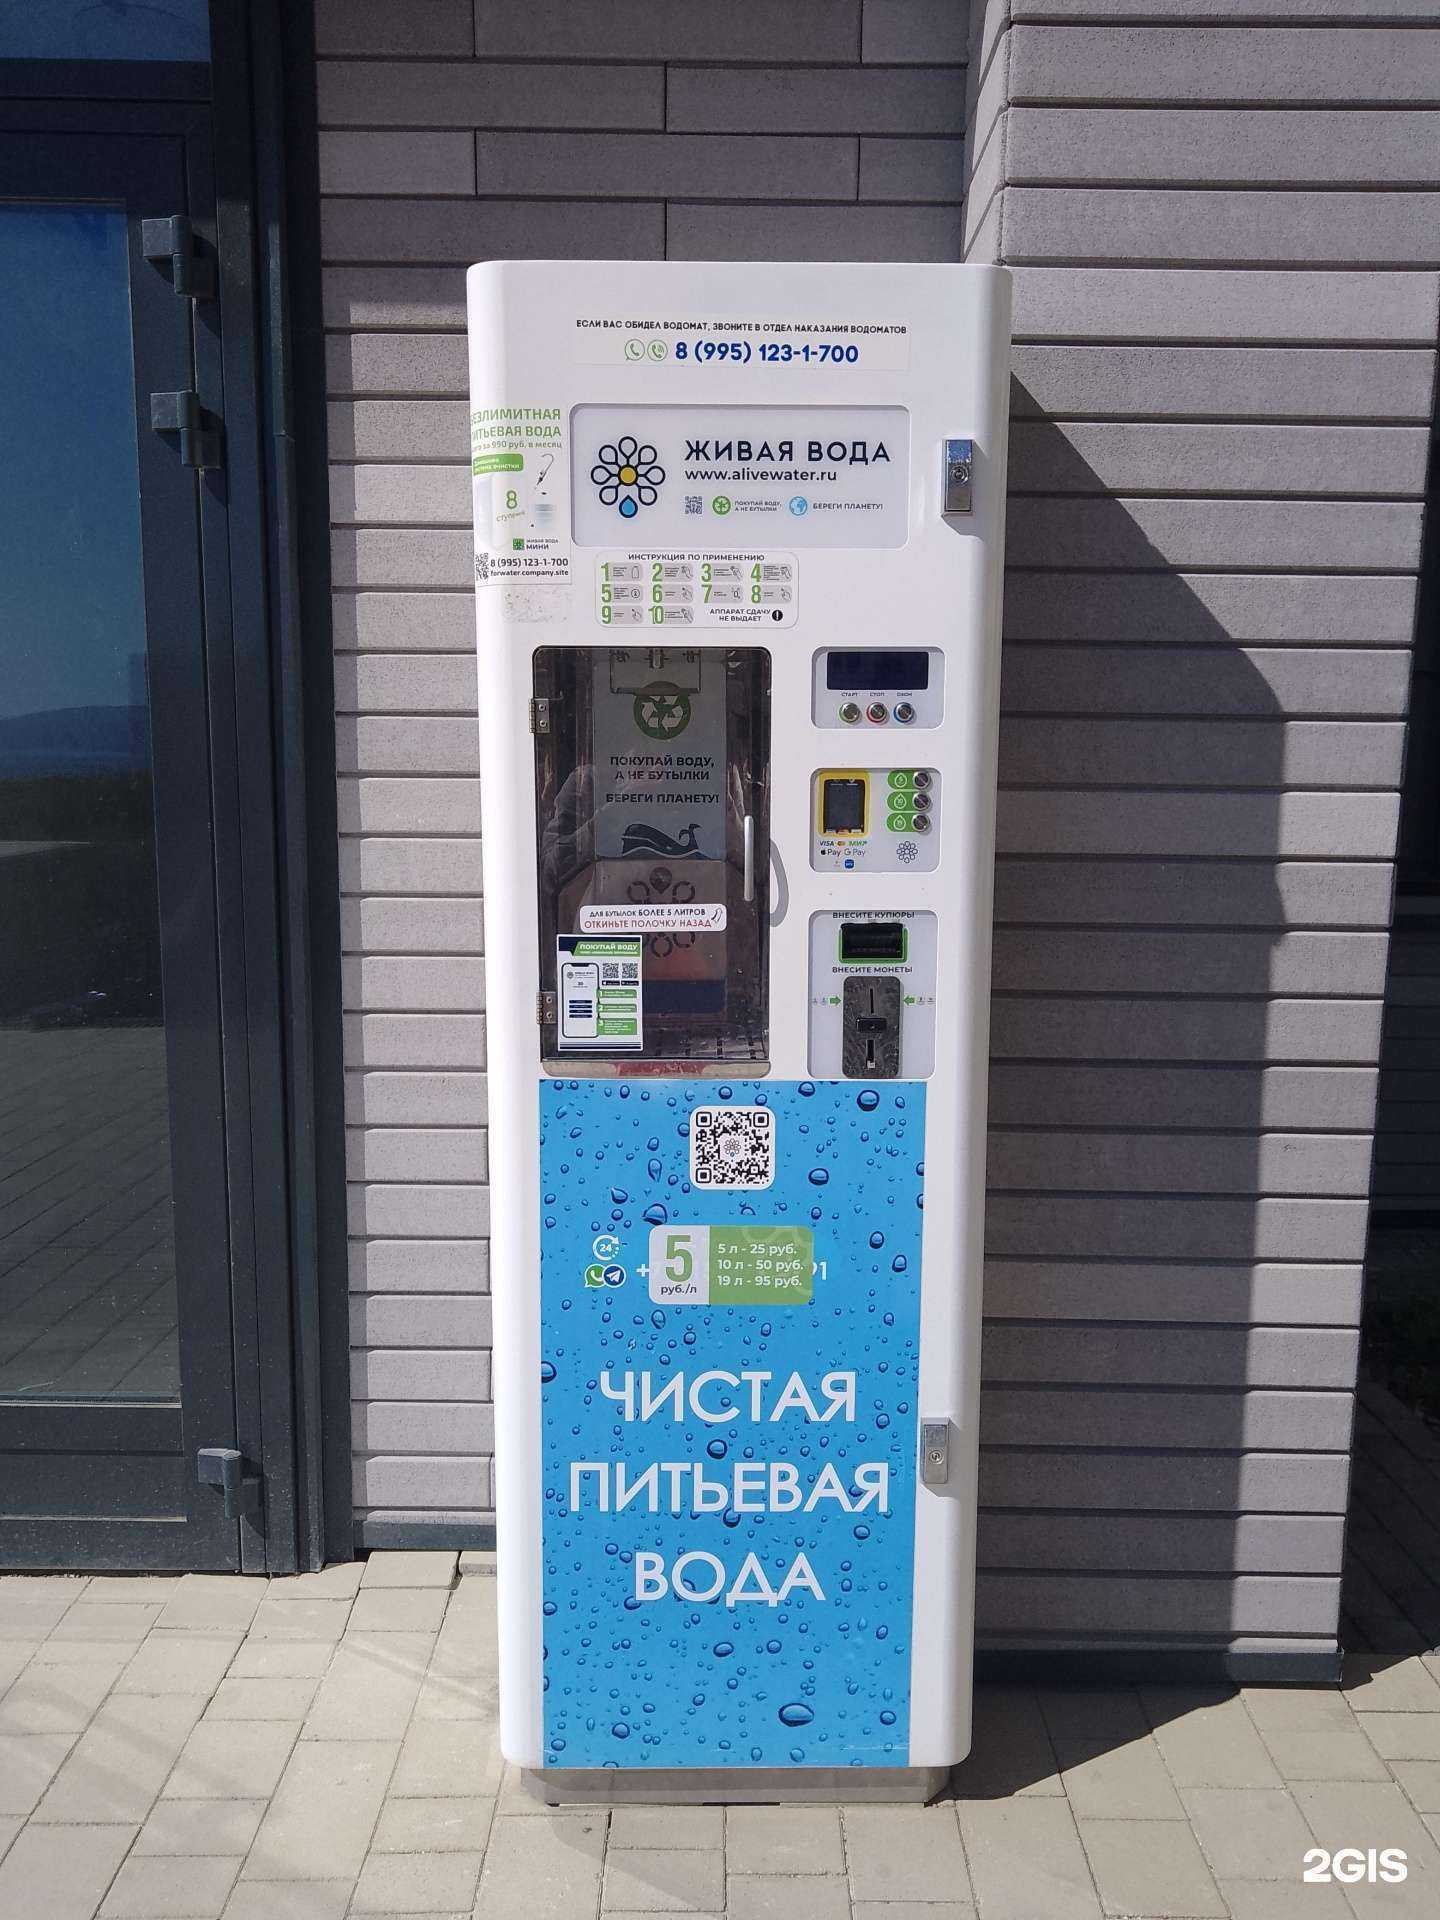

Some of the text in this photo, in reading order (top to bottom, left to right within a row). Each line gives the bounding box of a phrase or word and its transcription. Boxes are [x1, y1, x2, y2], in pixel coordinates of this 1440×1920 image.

[576, 320, 906, 335] ЕСЛИ ВАС ОБИДЕЛ ВОДОМАТ, ЗВОНИТЕ В ОТДЕЛ НАКАЗАНИЯ ВОДОМАТОВ
[675, 340, 859, 363] 8 (995) 123-1-700
[471, 408, 561, 425] ЕЗЛИМИТНАЯ
[472, 426, 561, 441] ИТЬЕВАЯ ВОДА
[685, 440, 890, 465] ЖИВАЯ ВОДА
[685, 468, 837, 482] www.alivewater.ru
[506, 490, 518, 509] 8
[813, 502, 883, 510] БЕРЕГИ ПЛАНЕТУ!
[490, 558, 568, 568] 8 (995) 123-1-700
[628, 553, 685, 562] ИНСТРУКЦИЯ
[601, 563, 610, 582] 1
[652, 563, 663, 582] 2
[701, 563, 712, 582] 3
[750, 563, 761, 582] 4
[601, 584, 612, 603] 5
[652, 584, 663, 603] 6
[701, 585, 713, 603] 7
[751, 585, 761, 603] 8
[601, 605, 612, 624] 9
[648, 605, 664, 624] 10
[732, 615, 761, 623] ВЫДАЕТ
[610, 754, 715, 769] ПОКУПАЙ ВОДУ,
[614, 771, 709, 781] А НЕ БУТЫЛКИ
[606, 794, 719, 804] БЕРЕГИ ПЛАНЕТУ!
[827, 848, 841, 857] Pay
[853, 848, 866, 857] Pay
[674, 908, 705, 916] ЛИТРОВ
[584, 919, 712, 929] ОТКИНЬТЕ ПОЛОЧКУ НАЗАД
[665, 1234, 693, 1282] 5
[717, 1244, 726, 1254] 5
[728, 1246, 738, 1254] л
[750, 1244, 766, 1254] 25
[769, 1243, 797, 1257] руб.
[717, 1259, 731, 1269] 10
[734, 1261, 744, 1270] л
[755, 1260, 772, 1270] 50
[776, 1259, 804, 1273] руб.
[661, 1283, 697, 1296] руб./л
[717, 1275, 731, 1285] 19
[733, 1277, 743, 1286] л
[754, 1276, 771, 1286] 95
[774, 1275, 802, 1288] руб.
[600, 1370, 856, 1423] ЧИСТАЯ
[570, 1462, 889, 1513] ПИТЬЕВАЯ
[635, 1551, 826, 1607] ВОДА
